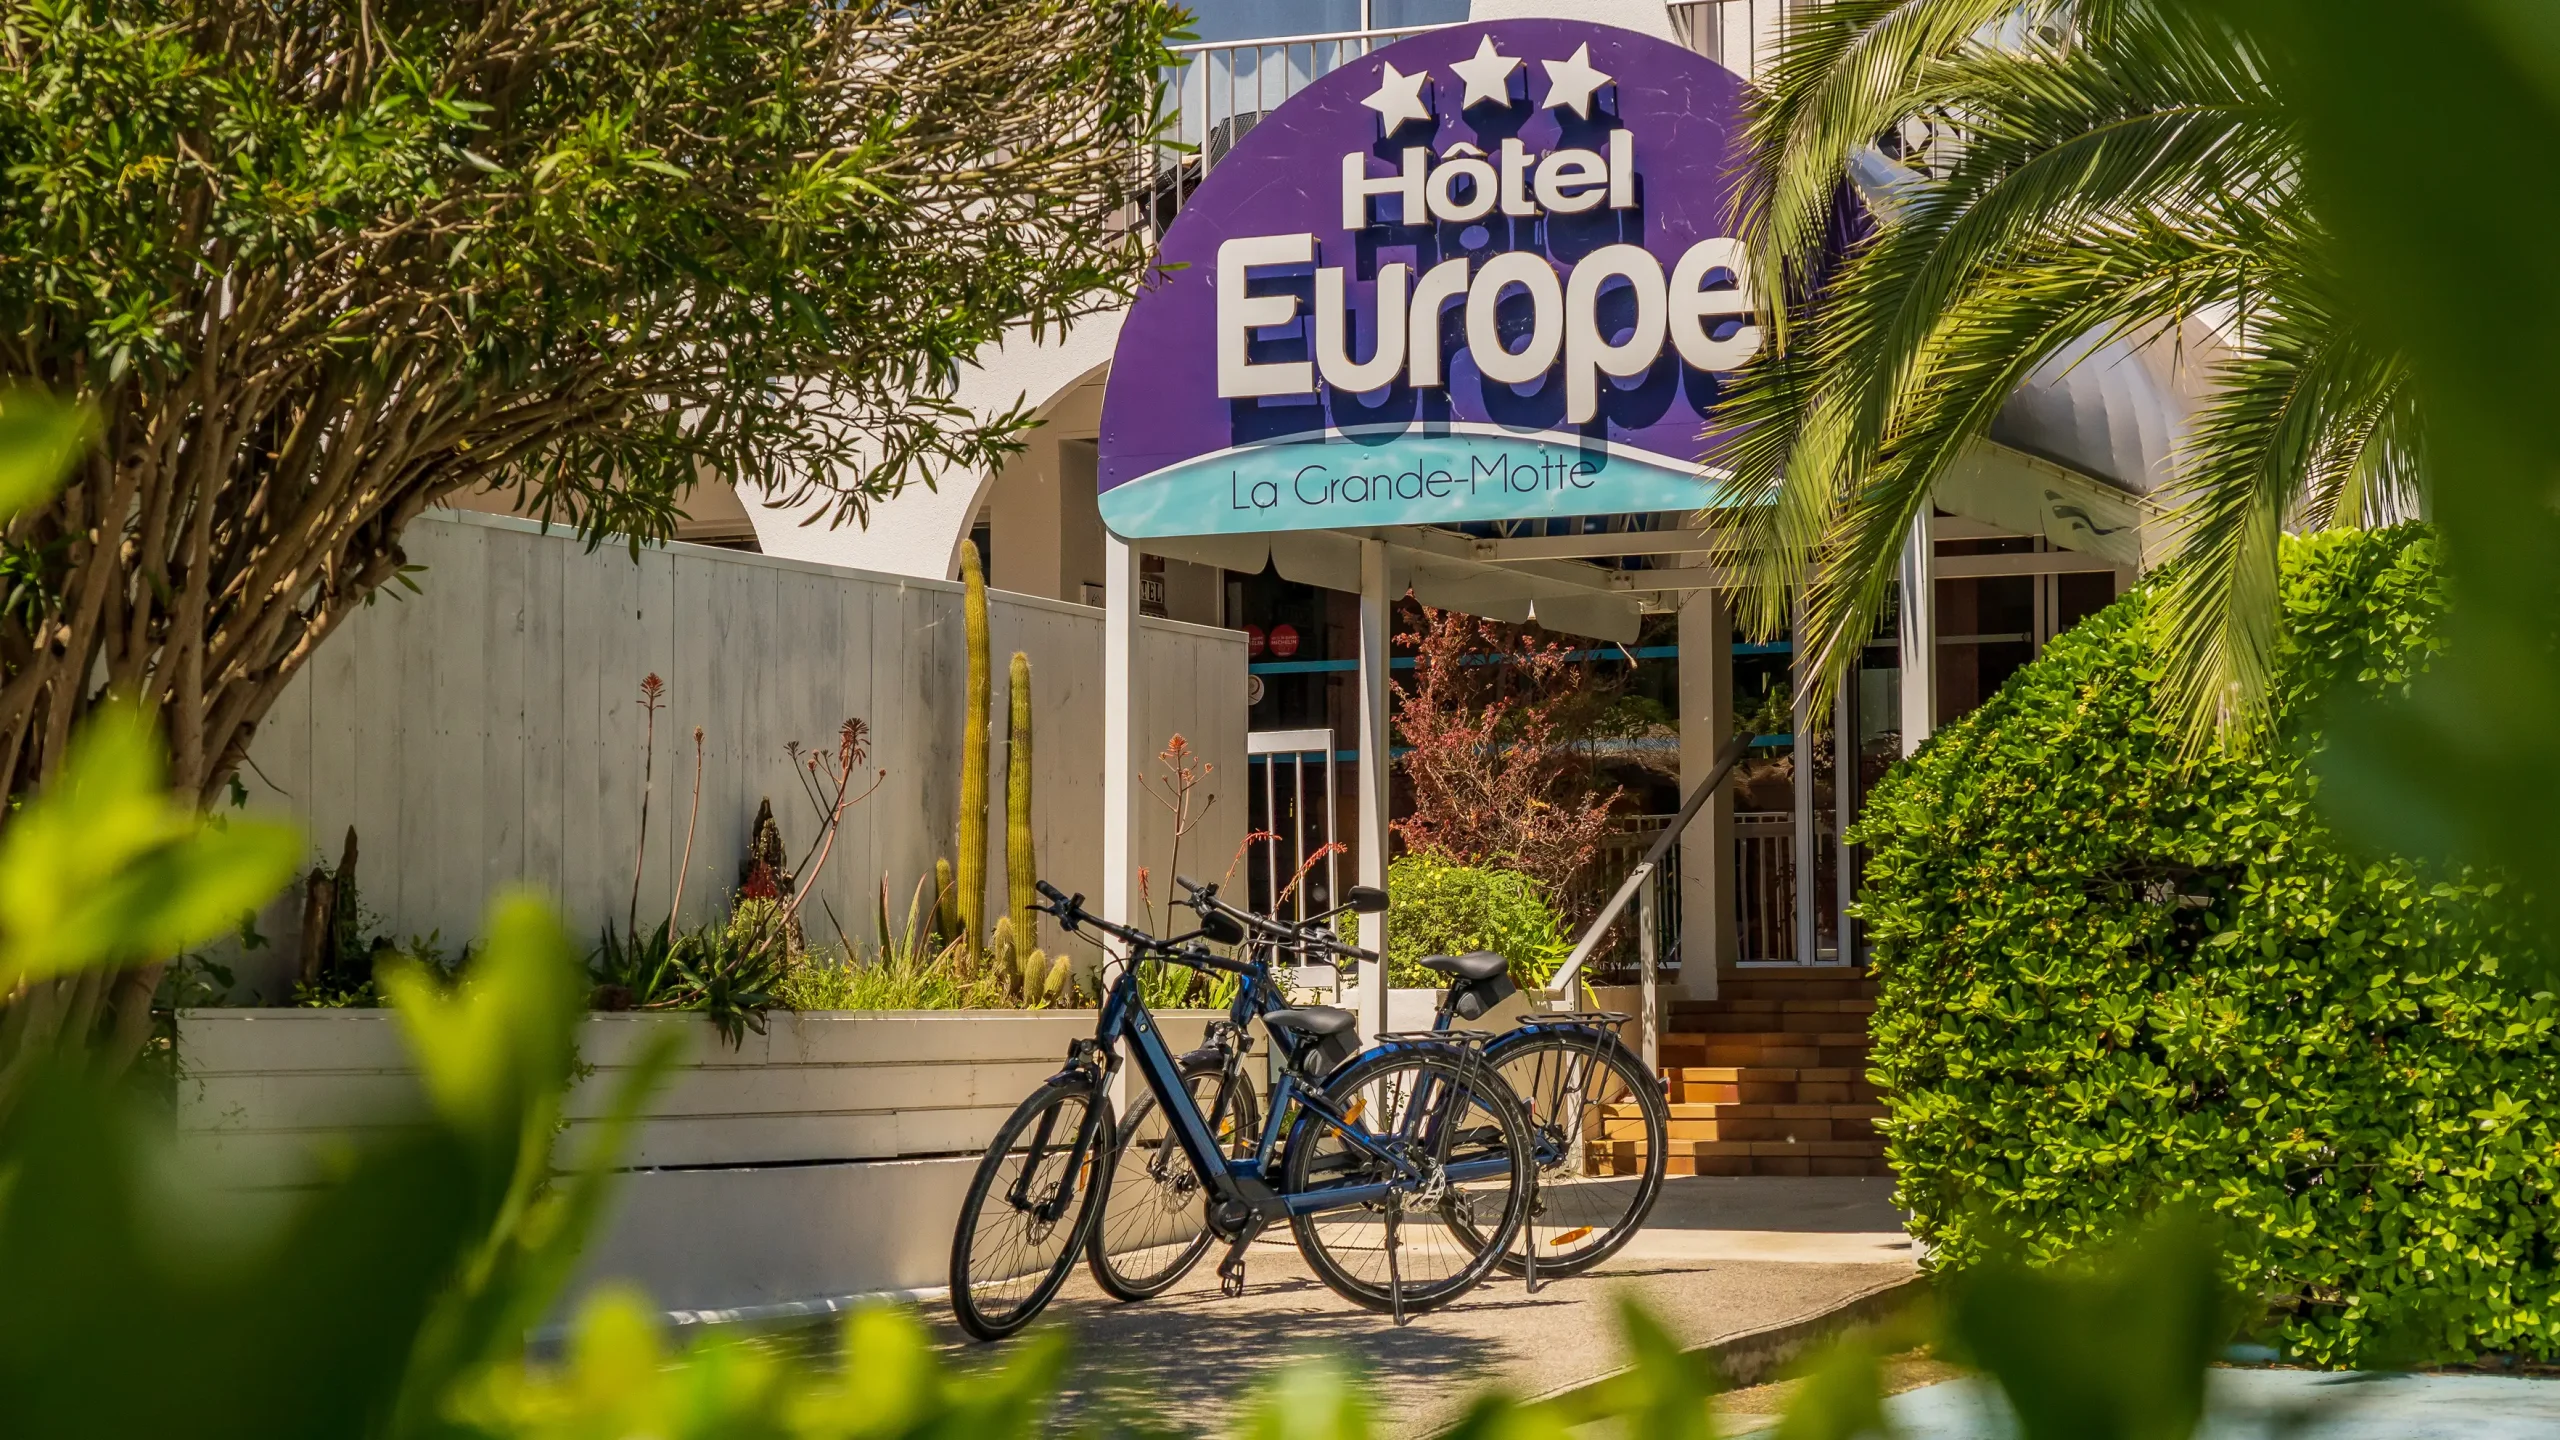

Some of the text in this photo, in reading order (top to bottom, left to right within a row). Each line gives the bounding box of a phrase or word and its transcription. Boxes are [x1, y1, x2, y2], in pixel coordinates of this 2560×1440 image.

[1342, 128, 1634, 230] Hôtel
[1217, 232, 1767, 425] Europe
[1232, 452, 1598, 510] La Grande-Motte
